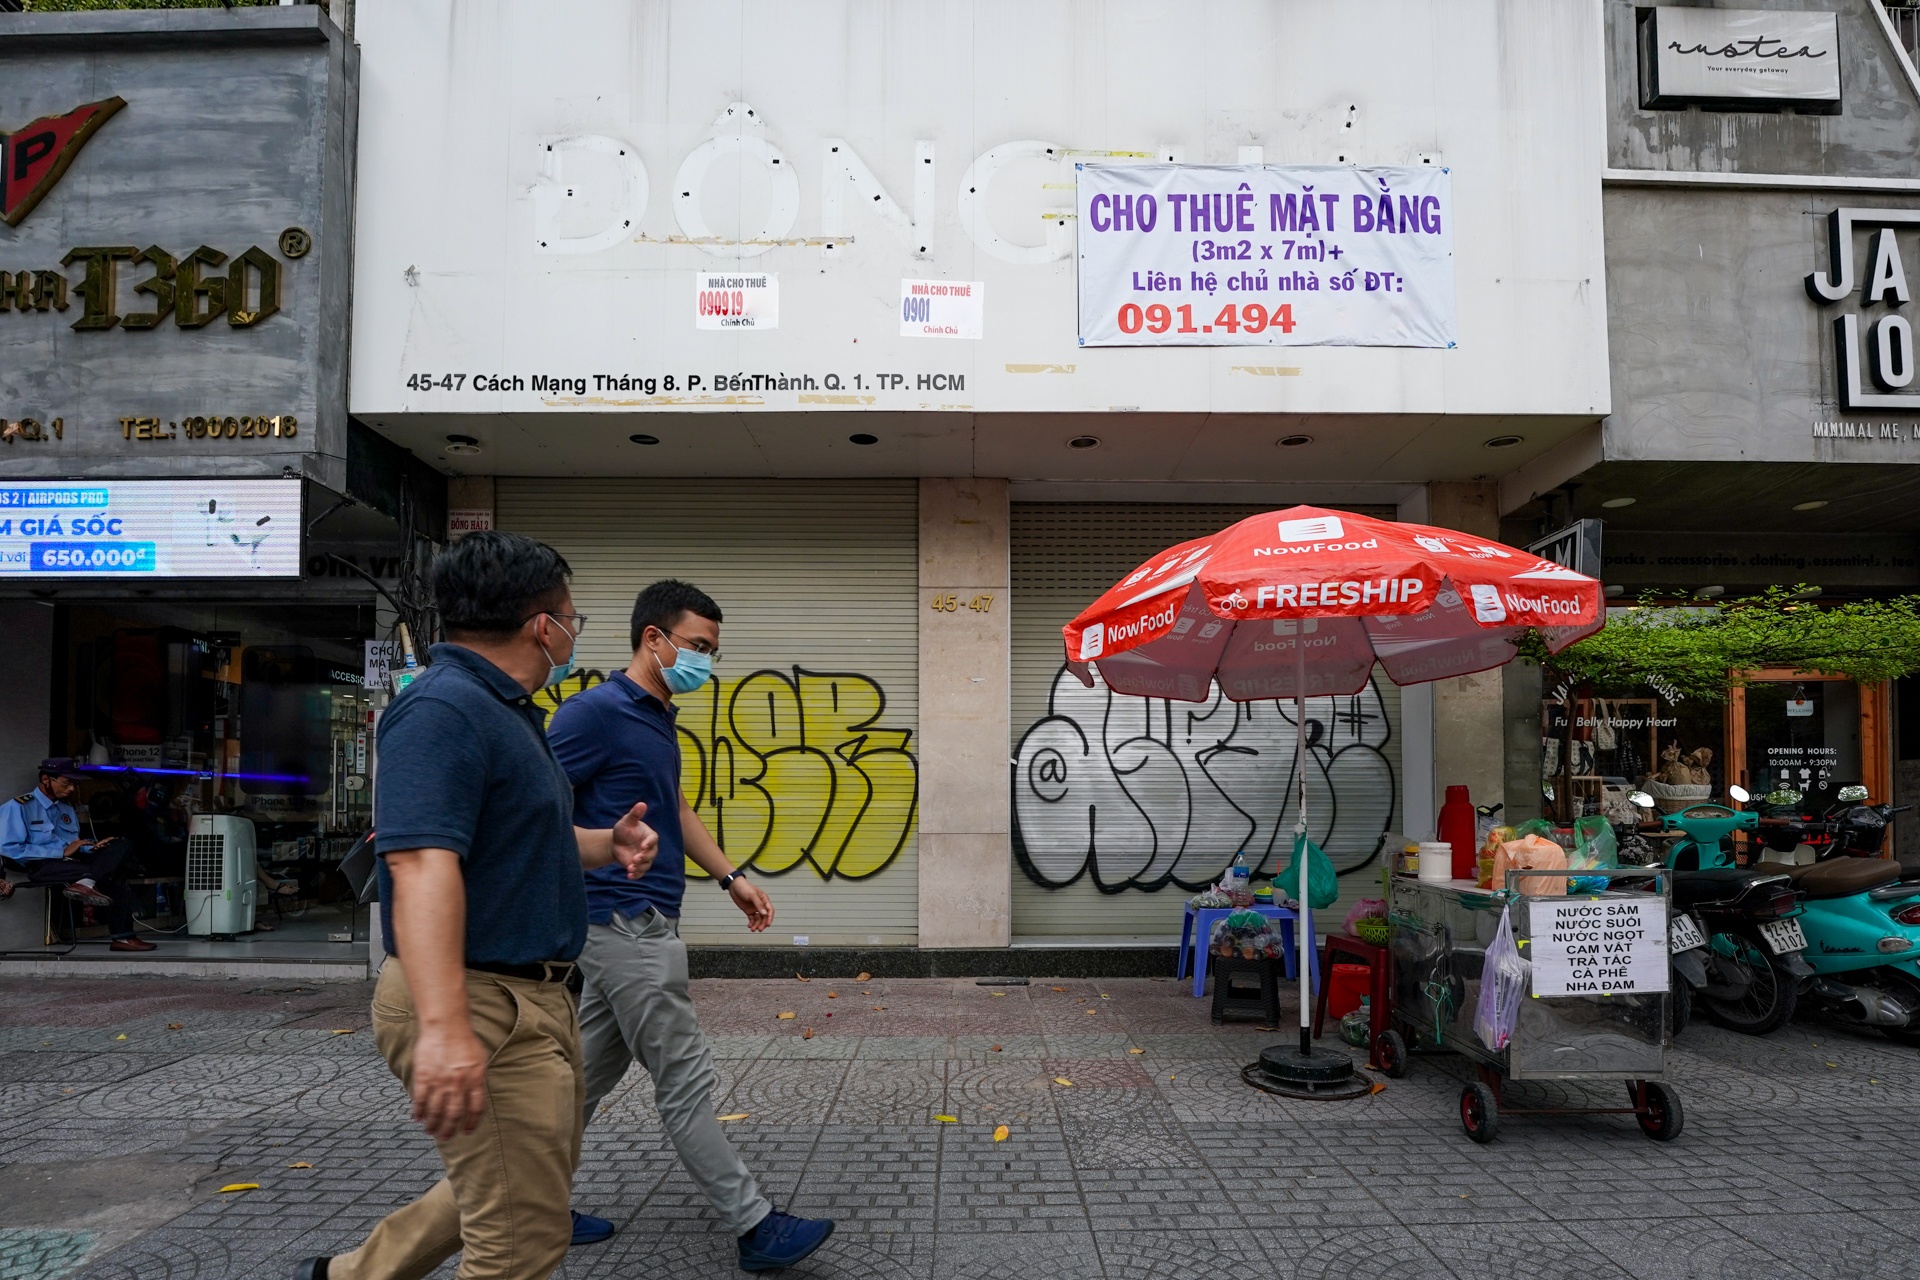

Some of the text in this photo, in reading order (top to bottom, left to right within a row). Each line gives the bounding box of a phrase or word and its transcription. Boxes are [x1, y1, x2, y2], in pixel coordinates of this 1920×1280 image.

[1725, 66, 1757, 74] everyday
[1759, 66, 1789, 74] getaway
[1090, 177, 1442, 239] CHO THUÊ MẶT BẰNG
[1192, 240, 1252, 263] (3m2
[1260, 245, 1273, 260] x
[708, 277, 767, 288] NHÀ CHO THUÊ
[1132, 267, 1403, 296] Liên hệ chủ nhà số ĐT:
[911, 284, 972, 297] NHÀ CHO THUÊ
[903, 297, 930, 323] 0901
[721, 318, 755, 327] Chính Chủ
[1117, 303, 1296, 334] 091.494
[923, 325, 959, 335] Chính Chủ
[406, 373, 467, 391] 45-47
[472, 374, 525, 391] Cách
[531, 374, 586, 395] Mạng
[593, 374, 657, 395] Tháng
[663, 375, 680, 391] 8.
[688, 375, 706, 391] P.
[824, 373, 846, 390] Q.
[853, 374, 870, 390] 1.
[877, 374, 909, 390] TP.
[917, 374, 965, 391] HCM
[1813, 421, 1874, 438] MINIMAL
[12, 492, 20, 505] 2
[28, 491, 78, 505] AIRPODS
[81, 491, 105, 505] PRO
[20, 514, 63, 536] GIÁ
[71, 512, 123, 536] SỐC
[484, 520, 489, 530] 2
[1657, 554, 1738, 566] accessories
[1750, 553, 1805, 570] clothing
[1256, 578, 1423, 609] FREESHIP
[1506, 593, 1581, 615] NowFood
[1107, 604, 1175, 645] NowFood
[1576, 717, 1603, 729] Belly
[1607, 717, 1644, 729] Happy
[1646, 717, 1677, 727] Heart
[113, 747, 160, 756] iPhone 12
[1557, 904, 1639, 917] NƯỚC SÂM
[1555, 918, 1601, 930] NƯỚC
[1552, 930, 1645, 942] NƯỚC NGỌT
[1566, 945, 1600, 954] CAM
[1774, 934, 1804, 952] 2102
[1568, 955, 1598, 966] TRÀ
[1572, 966, 1628, 979] CÀ PHÊ
[1566, 980, 1635, 992] NHA ĐAM
